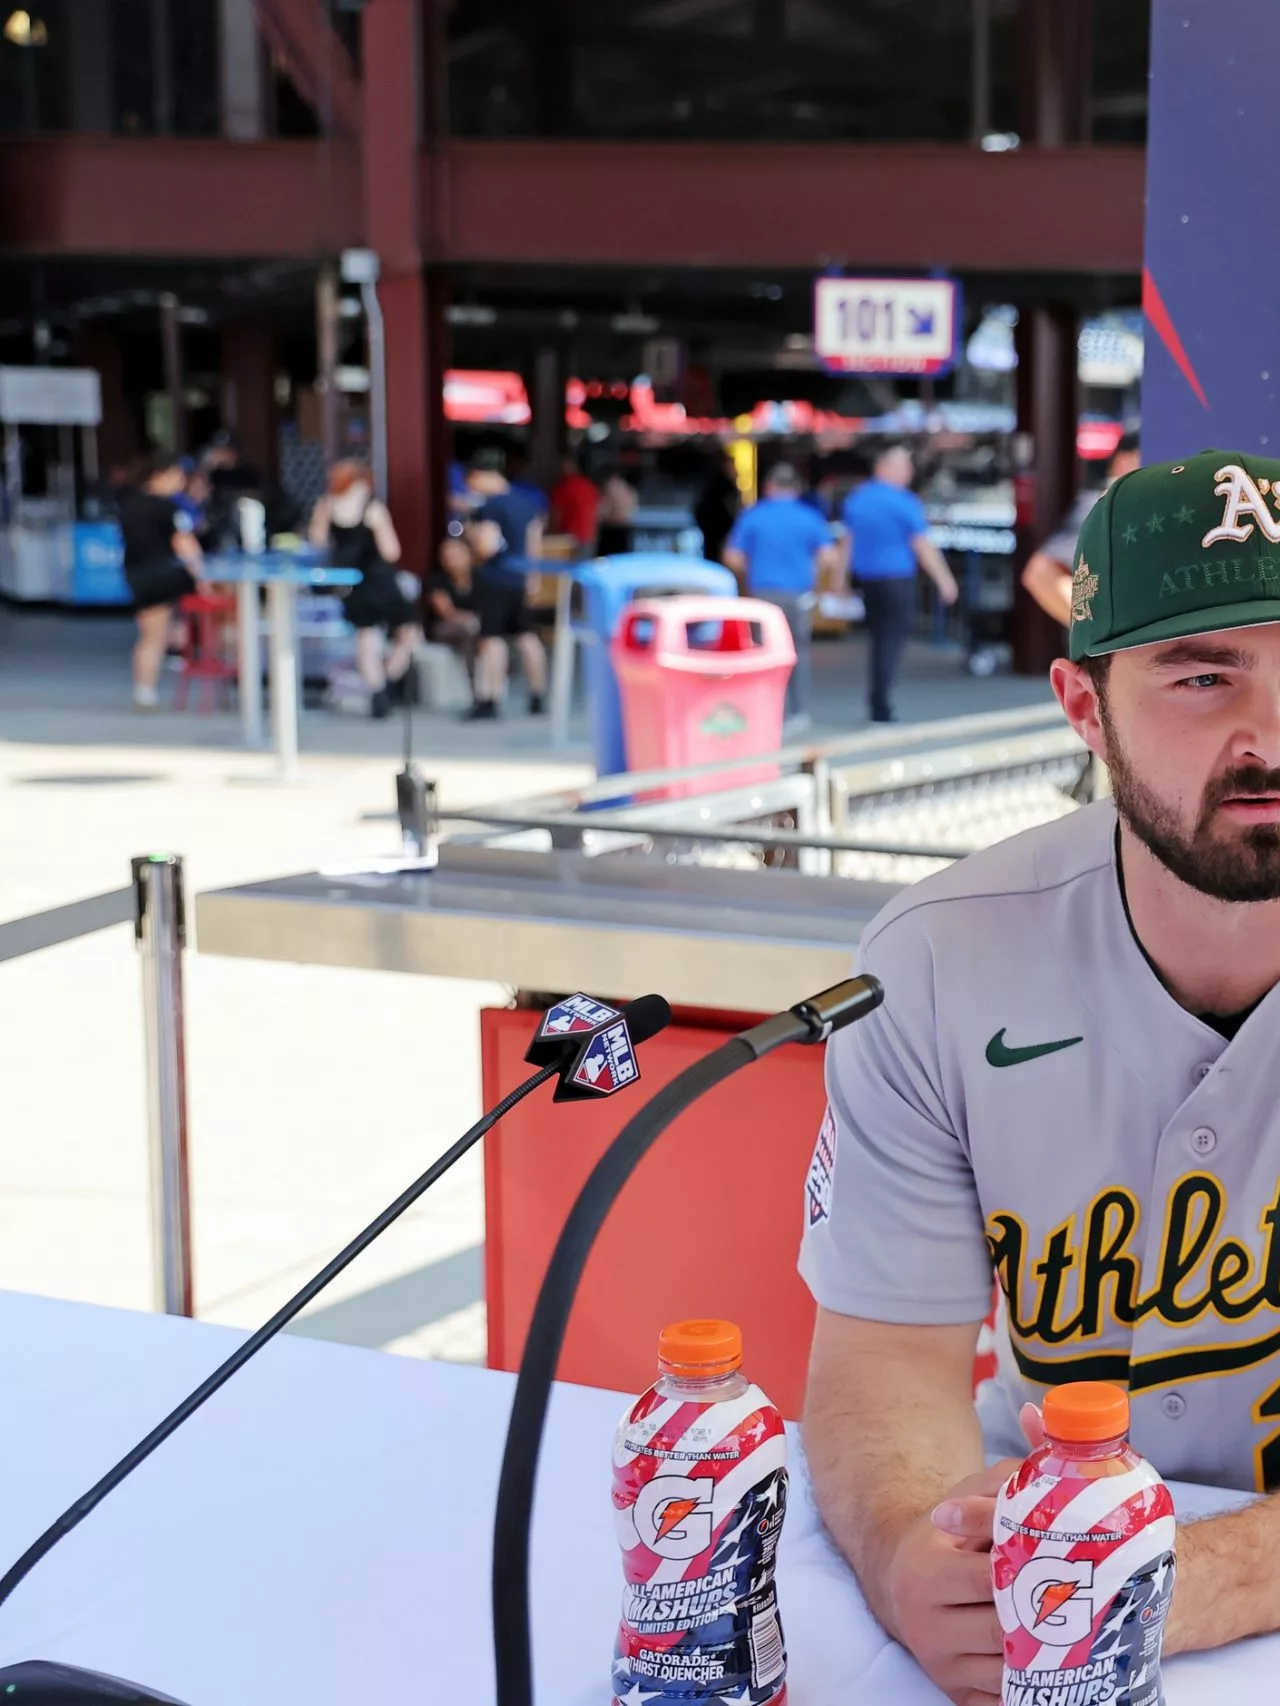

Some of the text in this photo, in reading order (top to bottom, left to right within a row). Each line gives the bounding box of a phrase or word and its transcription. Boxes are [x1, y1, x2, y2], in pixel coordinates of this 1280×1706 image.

[834, 298, 895, 342] 101
[564, 995, 615, 1021] MLB
[607, 1023, 636, 1083] MLB
[653, 1449, 686, 1461] BETTER
[687, 1452, 712, 1461] THAN
[712, 1450, 740, 1461] WATER
[632, 1474, 715, 1560] G
[1029, 1528, 1064, 1542] BETTER
[1065, 1532, 1090, 1542] THAN
[1090, 1531, 1123, 1542] WATER
[628, 1582, 738, 1623] MASHUPS
[1012, 1556, 1096, 1647] G
[638, 1609, 719, 1634] LIMITED EDITION
[628, 1655, 725, 1681] THIRST QUENCHER
[1007, 1673, 1118, 1706] MASHUPS
